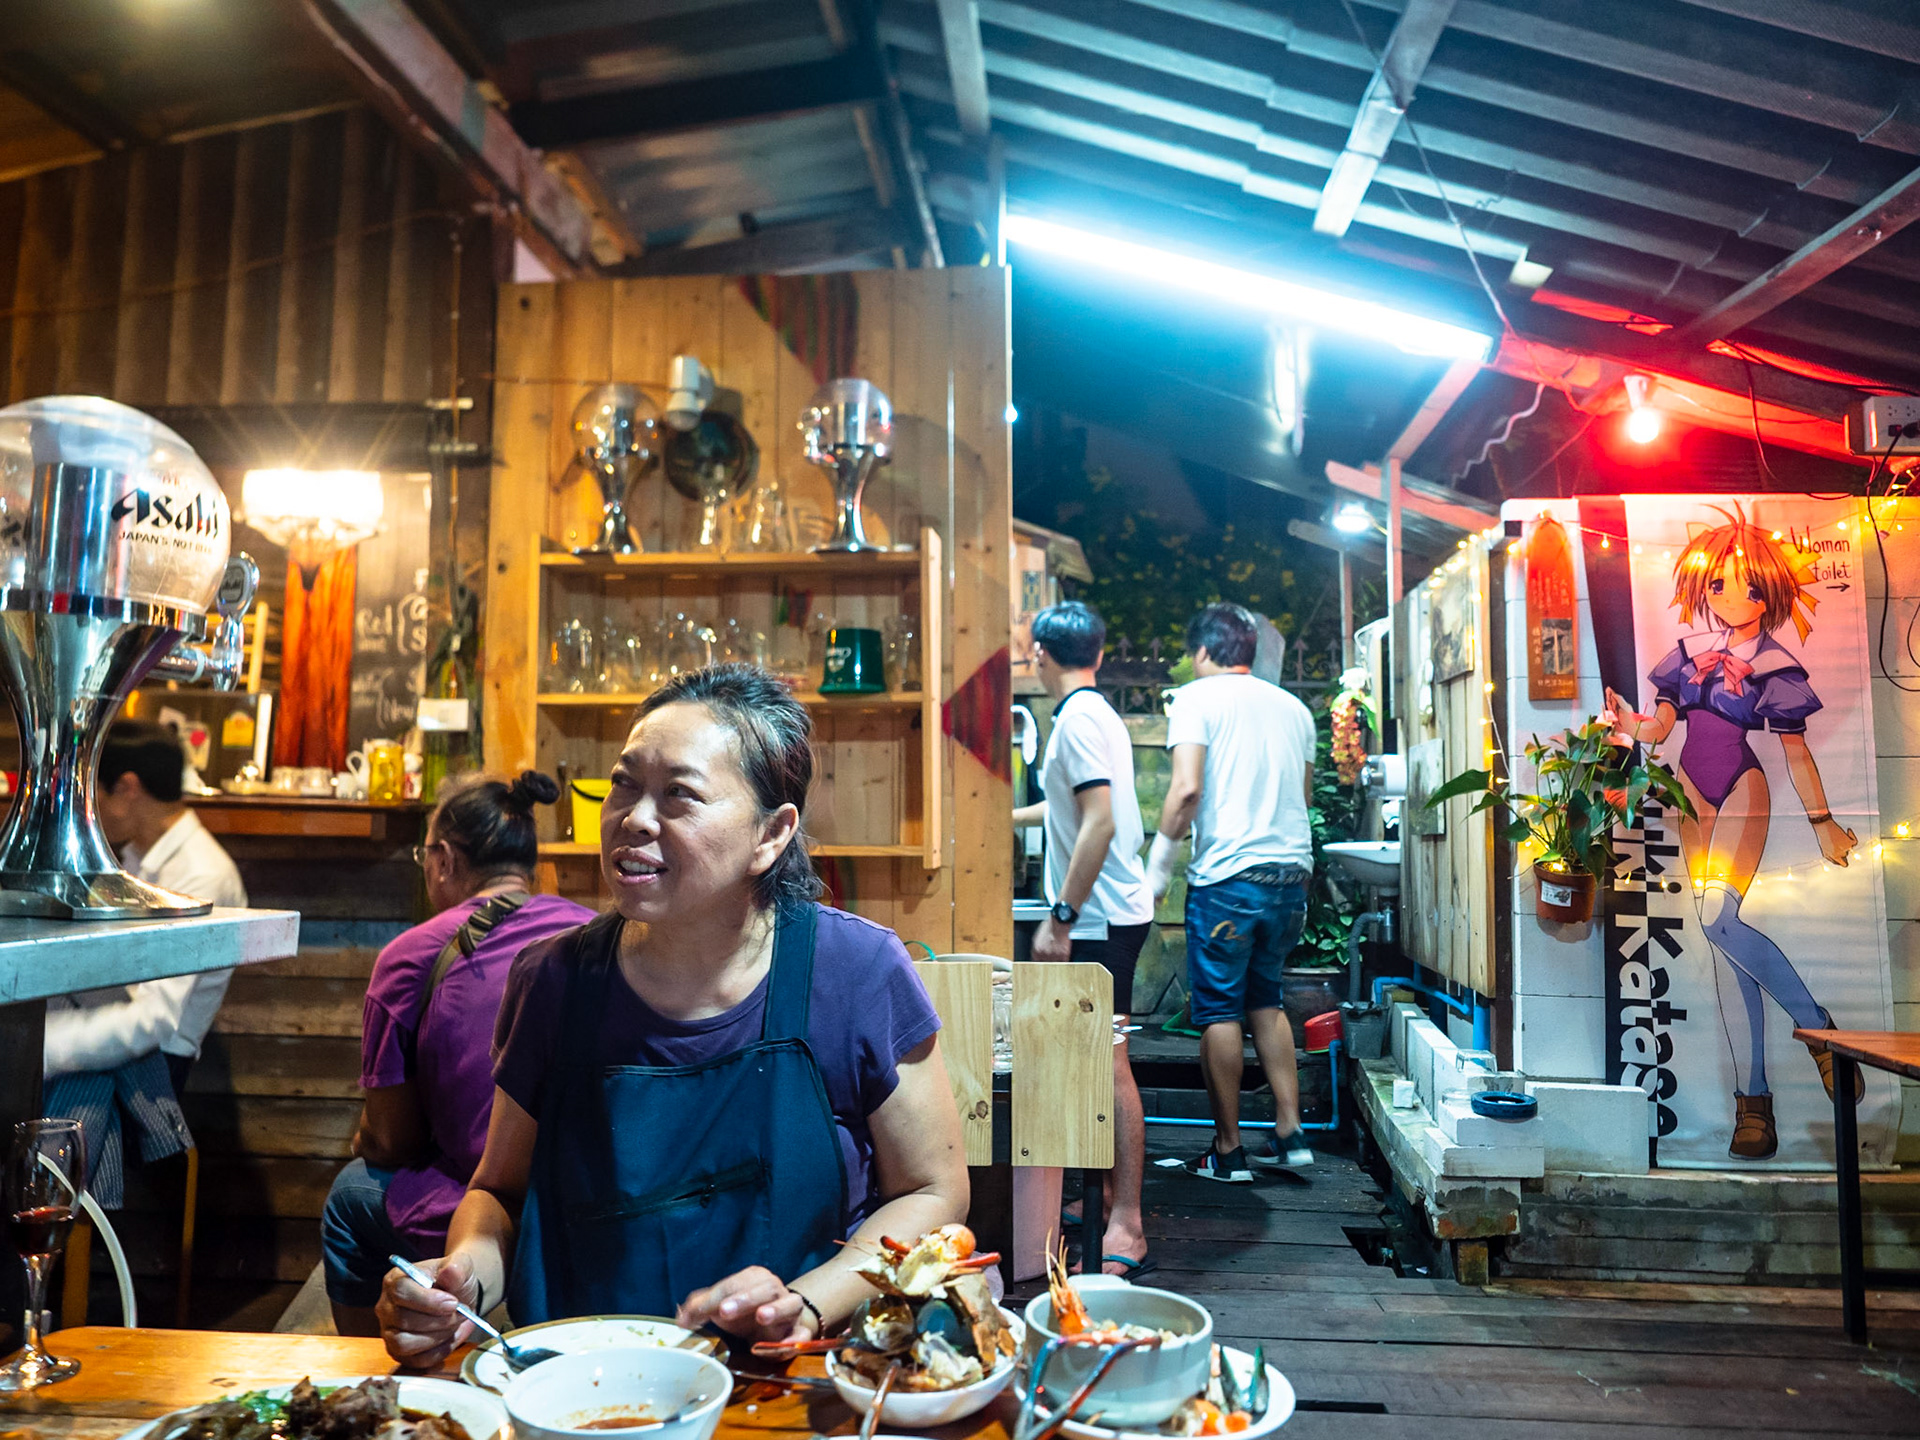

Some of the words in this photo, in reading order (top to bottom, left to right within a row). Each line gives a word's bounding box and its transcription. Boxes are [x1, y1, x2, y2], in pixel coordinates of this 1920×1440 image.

[111, 487, 219, 539] Asahi
[1789, 525, 1851, 555] Woman
[1811, 560, 1852, 583] toilet
[1612, 763, 1682, 894] uki
